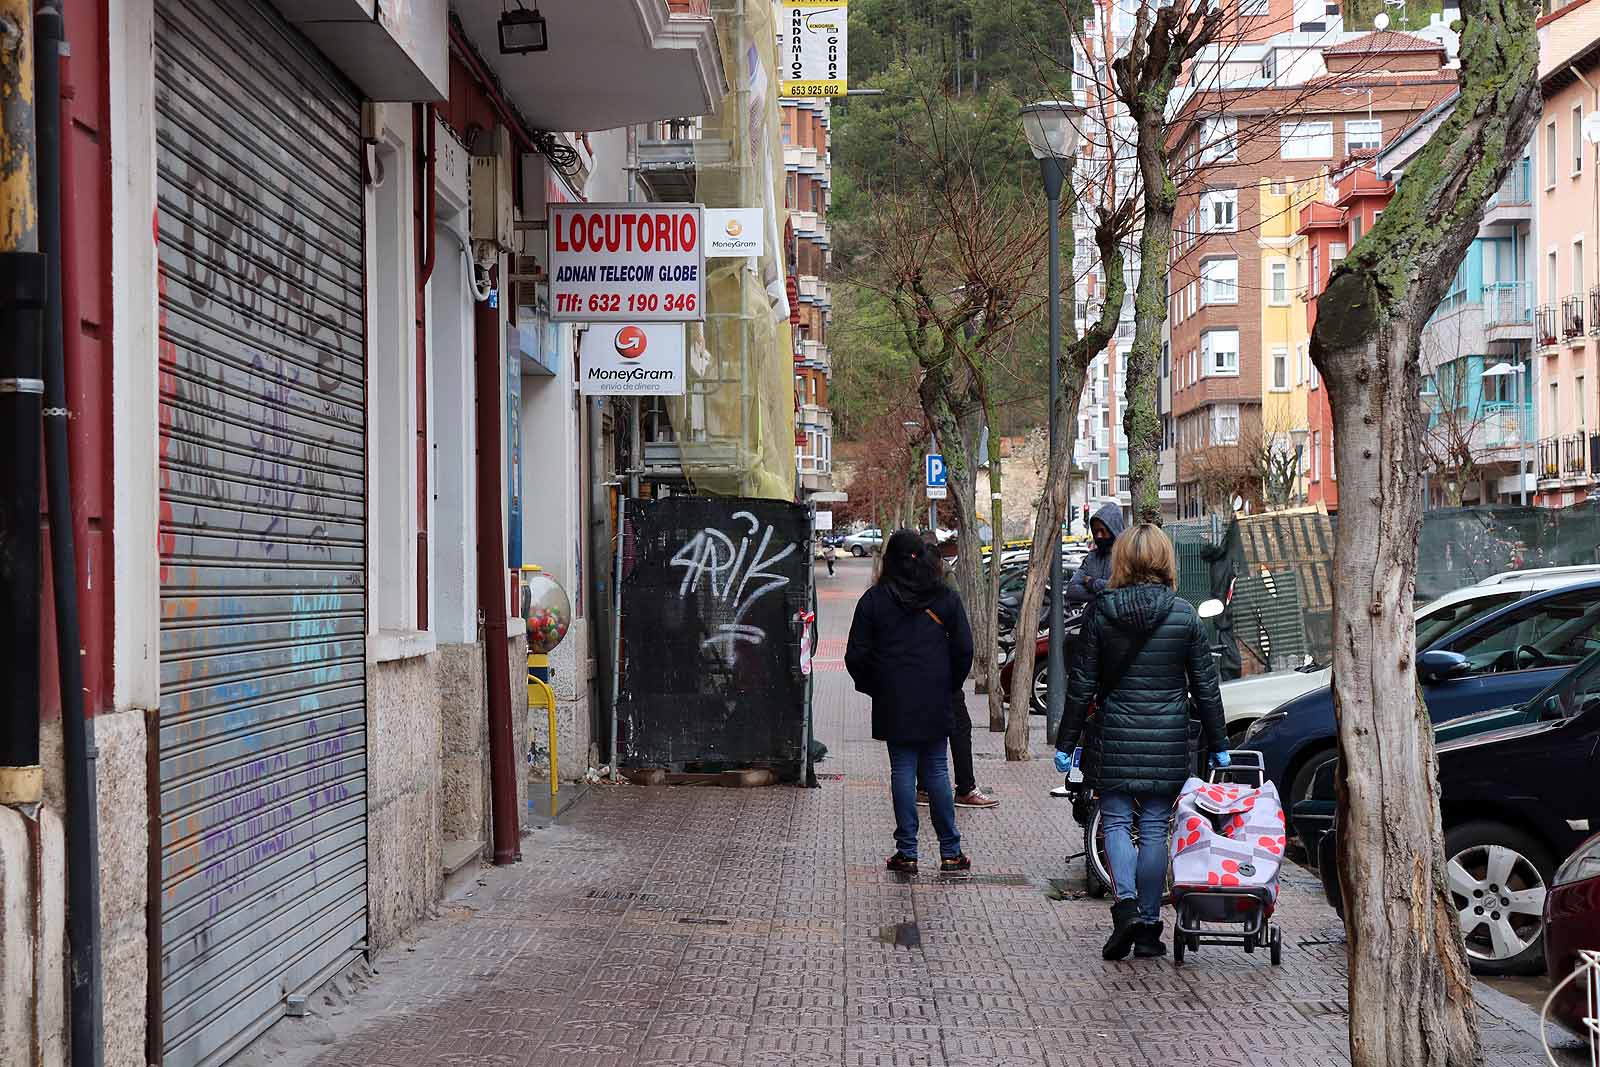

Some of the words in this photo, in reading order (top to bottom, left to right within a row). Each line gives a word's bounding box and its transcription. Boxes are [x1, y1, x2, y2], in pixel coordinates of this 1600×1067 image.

[792, 9, 802, 79] ANDAMIOS
[827, 36, 838, 79] GRUAS
[791, 86, 806, 95] 653
[807, 86, 822, 95] 925
[824, 85, 839, 95] 602
[555, 213, 697, 252] LOCUTORIO
[712, 240, 757, 248] MoneyGram
[556, 266, 597, 282] ADNAN
[599, 265, 654, 282] TELECOM
[658, 265, 698, 282] GLOBE
[588, 294, 621, 311] 632
[627, 294, 659, 311] 190
[664, 294, 696, 311] 346
[588, 367, 673, 382] MoneyGram
[623, 382, 633, 390] de
[634, 382, 660, 390] dinero
[931, 459, 942, 482] P
